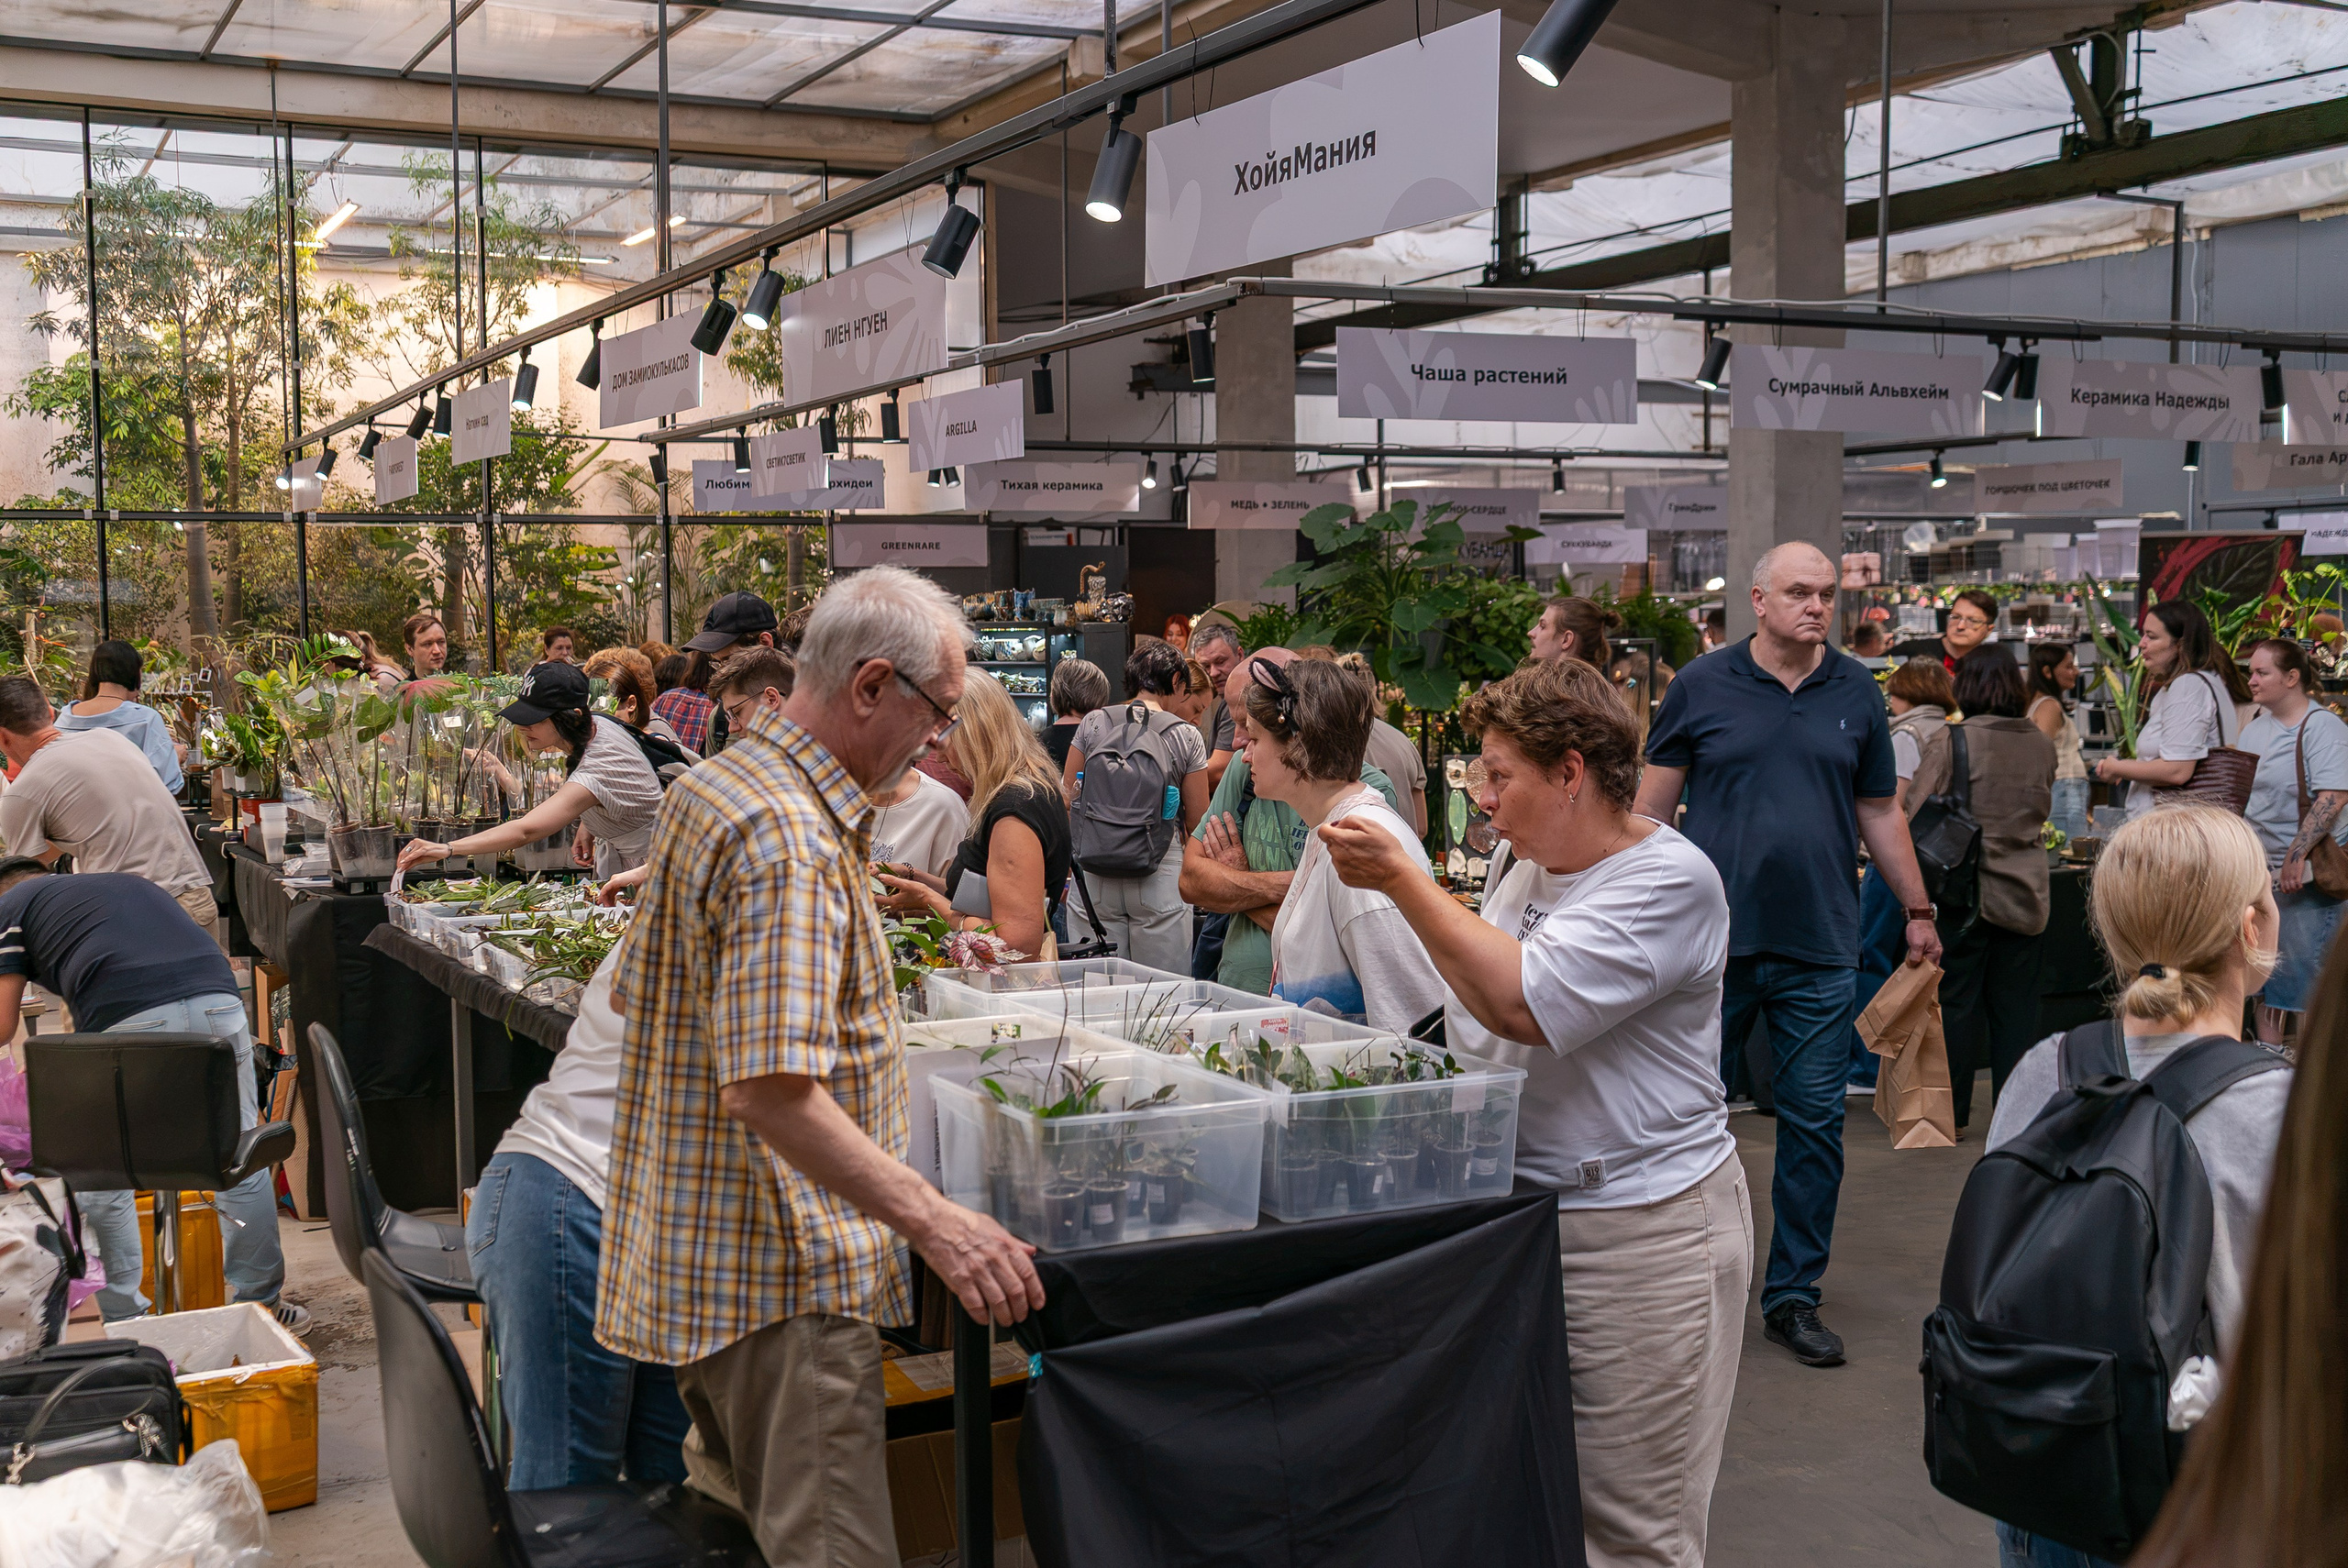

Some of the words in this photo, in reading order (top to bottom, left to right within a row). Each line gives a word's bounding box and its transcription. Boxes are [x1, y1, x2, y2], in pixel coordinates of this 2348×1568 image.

[1234, 129, 1377, 196] ХойяМания
[824, 321, 851, 349] ЛИЕН
[853, 310, 888, 340] НГУЕН
[612, 371, 628, 393] ДОМ
[628, 353, 690, 386] ЗАМИОКУЛЬКАСОВ
[1411, 364, 1467, 381] Чаша
[1473, 368, 1567, 386] растений
[1768, 378, 1865, 397] Сумрачный
[1868, 382, 1949, 399] Альвхейм
[2070, 388, 2151, 408] Керамика
[2154, 392, 2231, 411] Надежды
[945, 420, 978, 437] ARGILLA
[2289, 453, 2325, 466] Гала
[704, 479, 753, 490] Любим
[828, 480, 873, 491] рхидеи
[1001, 480, 1039, 491] Тихая
[1043, 480, 1103, 492] керамика
[1231, 500, 1259, 510] МЕДЬ
[1271, 501, 1310, 510] ЗЕЛЕНЬ
[881, 541, 941, 550] GREENRARE
